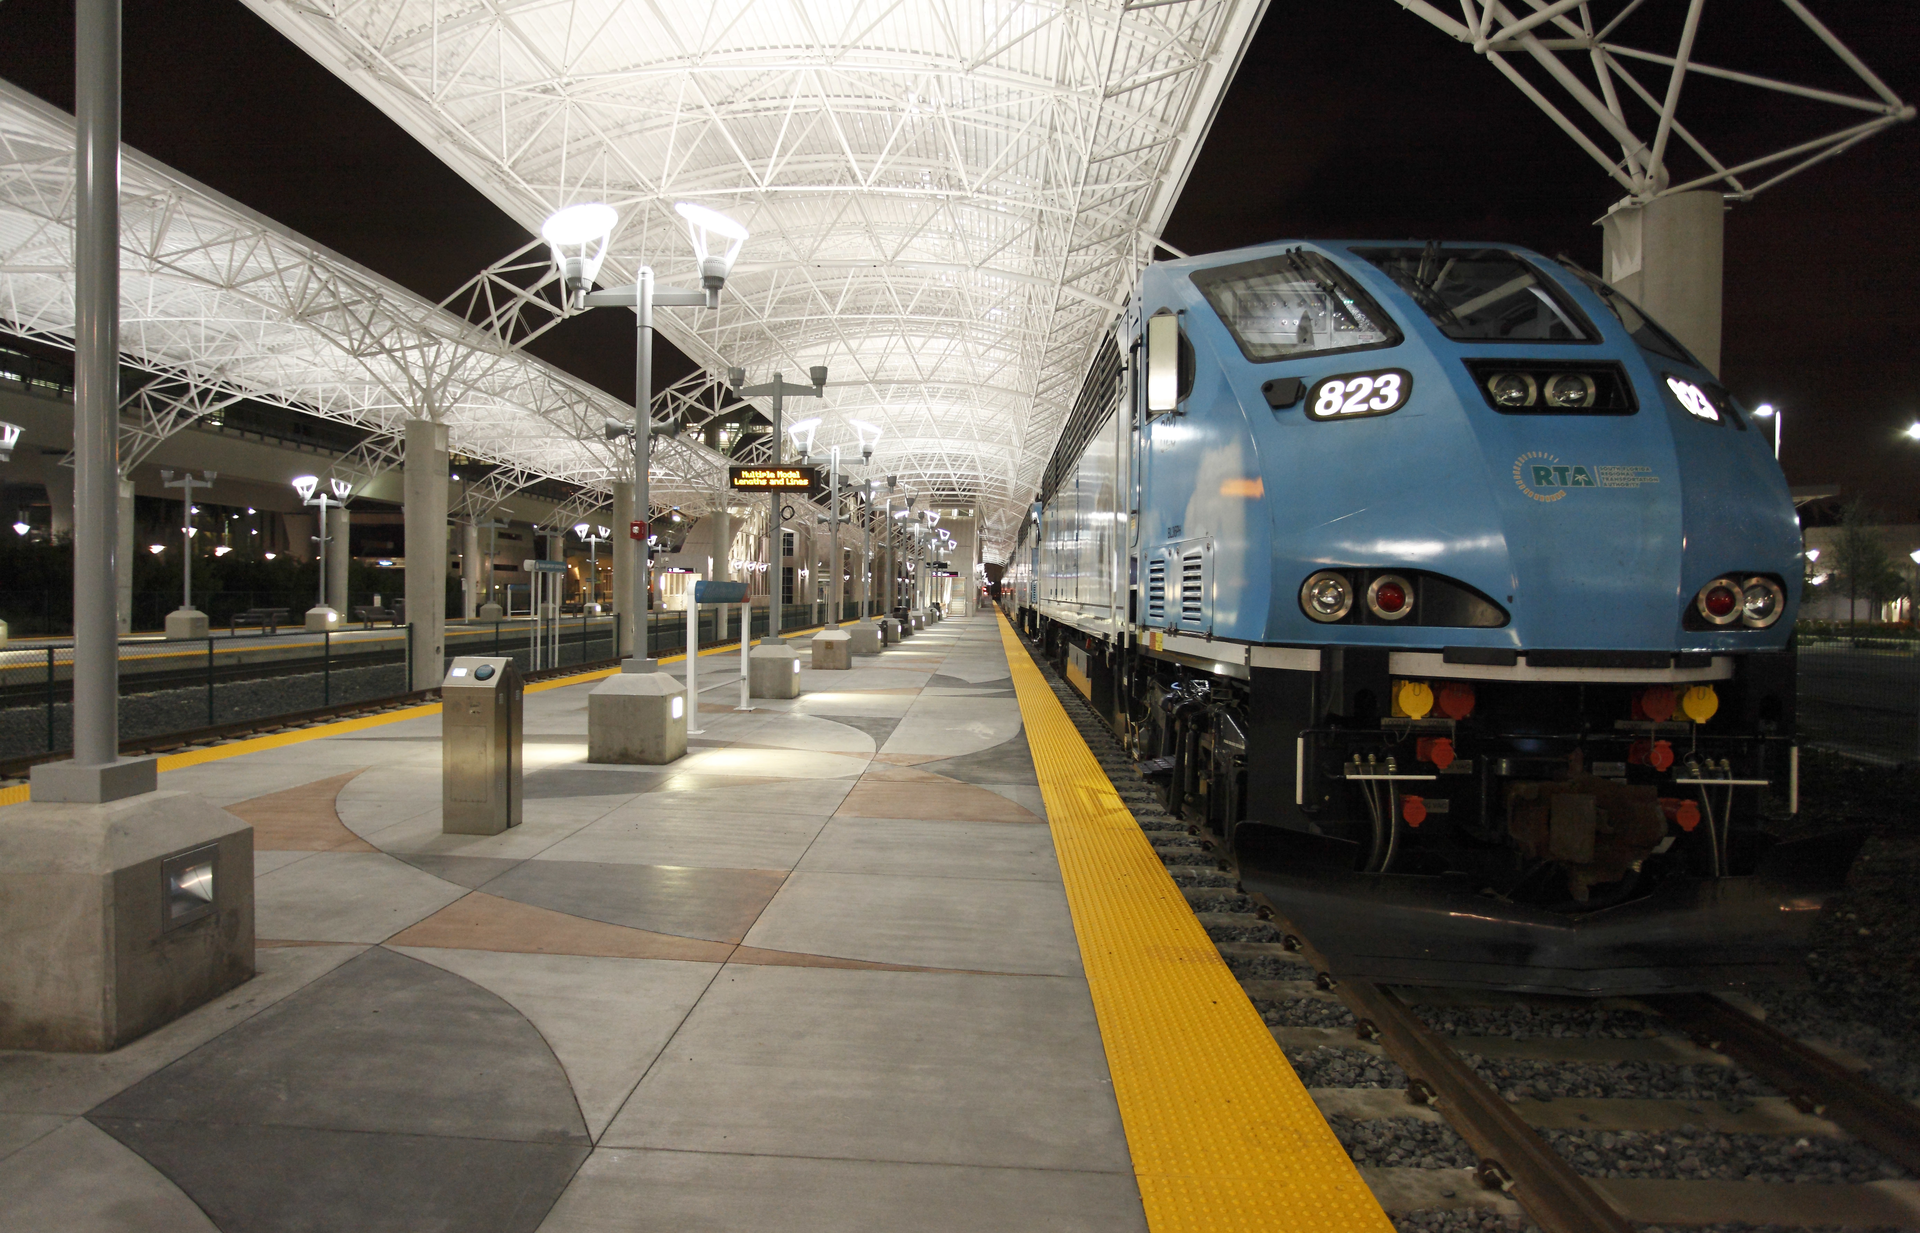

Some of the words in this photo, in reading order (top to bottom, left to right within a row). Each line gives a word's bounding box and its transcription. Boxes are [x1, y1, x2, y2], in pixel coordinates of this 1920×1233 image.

[1315, 374, 1401, 416] 823
[741, 470, 776, 478] Multiple
[1531, 465, 1597, 487] RTA
[734, 478, 768, 486] Lengths
[769, 478, 784, 486] and
[785, 478, 809, 486] Lines
